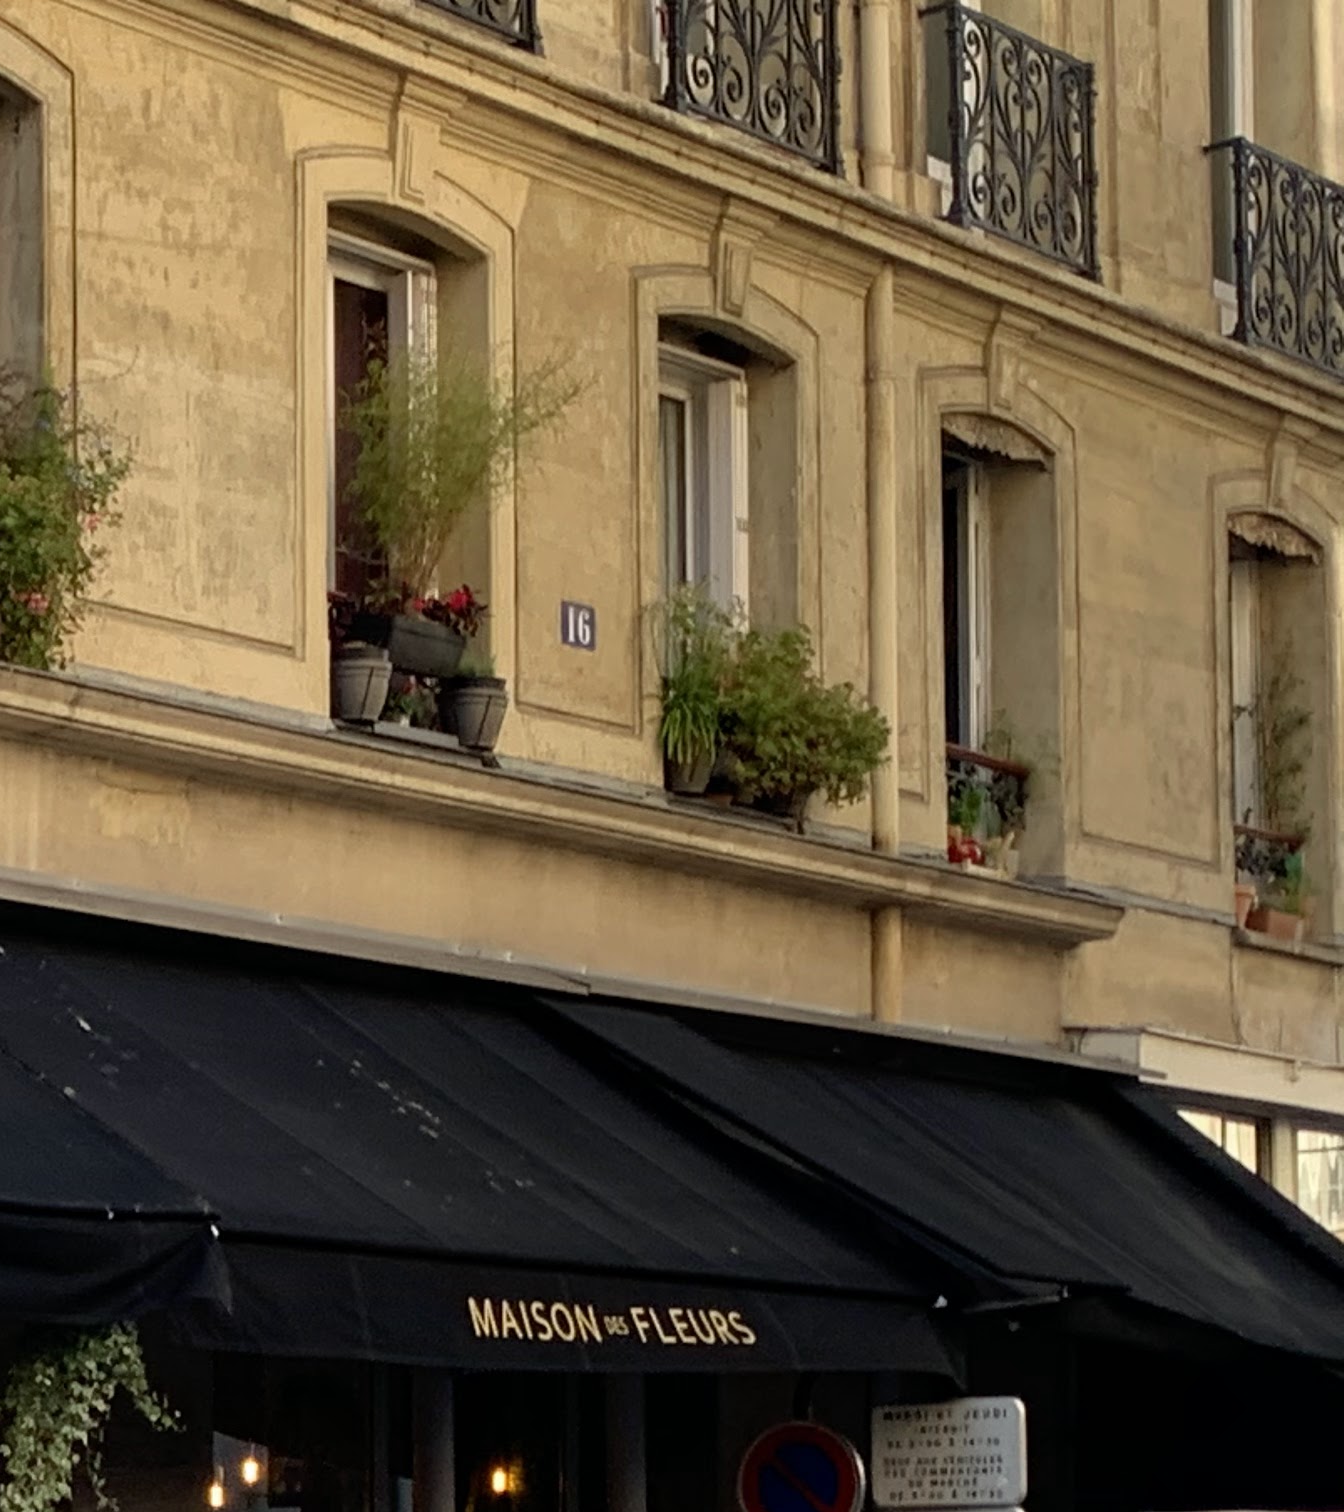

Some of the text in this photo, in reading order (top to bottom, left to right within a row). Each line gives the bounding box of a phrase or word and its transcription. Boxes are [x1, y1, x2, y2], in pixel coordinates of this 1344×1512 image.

[567, 605, 591, 646] 16
[467, 1296, 757, 1346] MAISON DES FLEURS
[963, 1407, 1008, 1420] JEUDI
